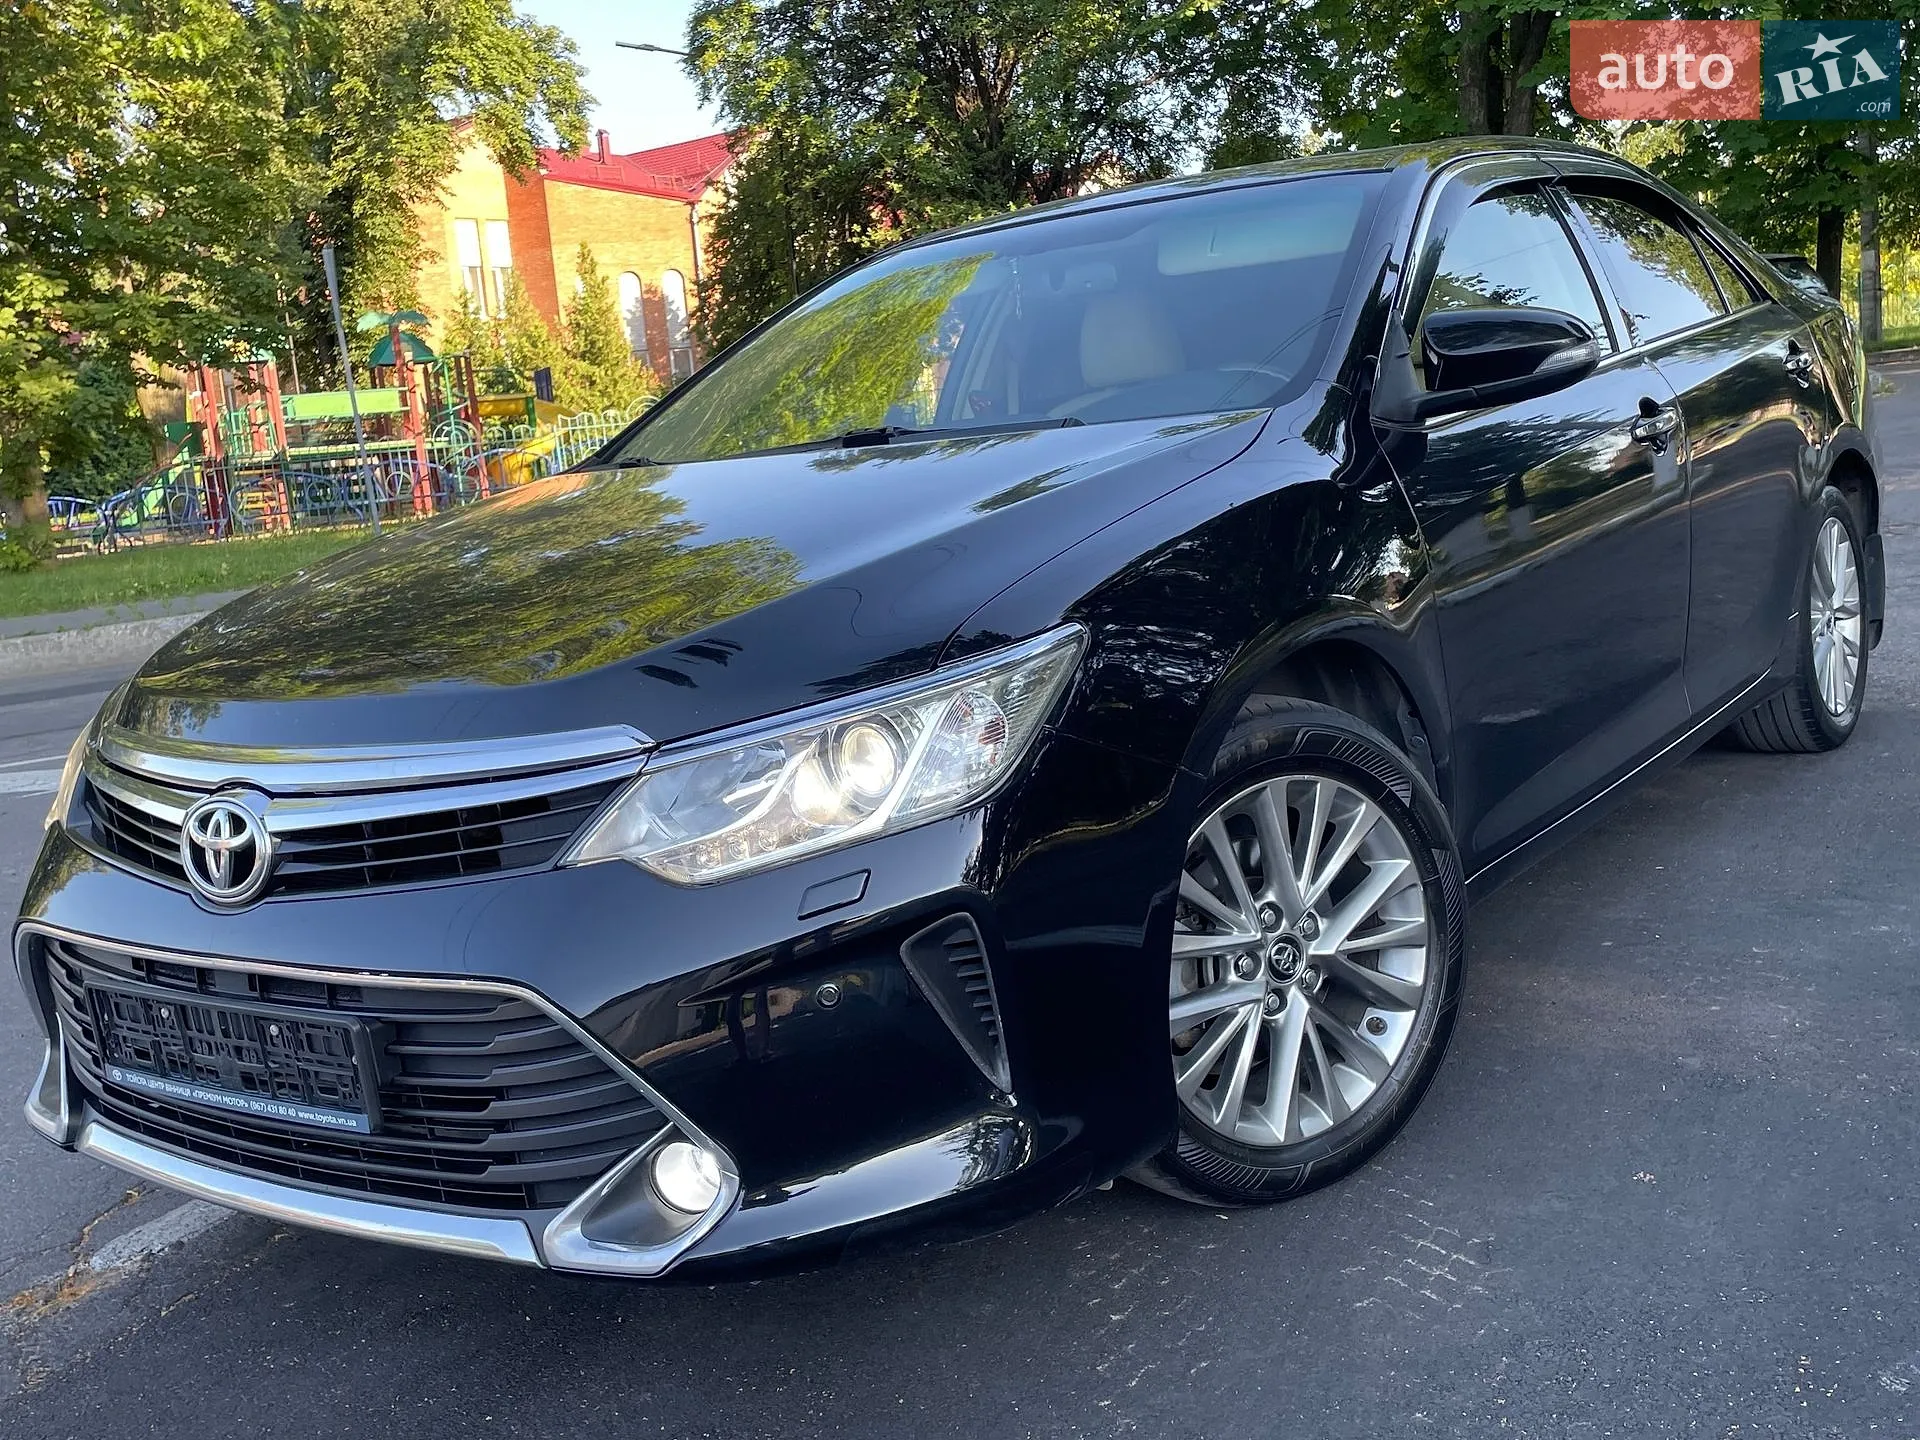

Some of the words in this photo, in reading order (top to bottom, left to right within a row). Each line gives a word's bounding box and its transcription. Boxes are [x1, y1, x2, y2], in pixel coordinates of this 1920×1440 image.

[267, 1103, 278, 1113] 431
[279, 1105, 287, 1115] 80
[288, 1107, 296, 1117] 40
[298, 1110, 357, 1127] www.toyota.vn.ua
